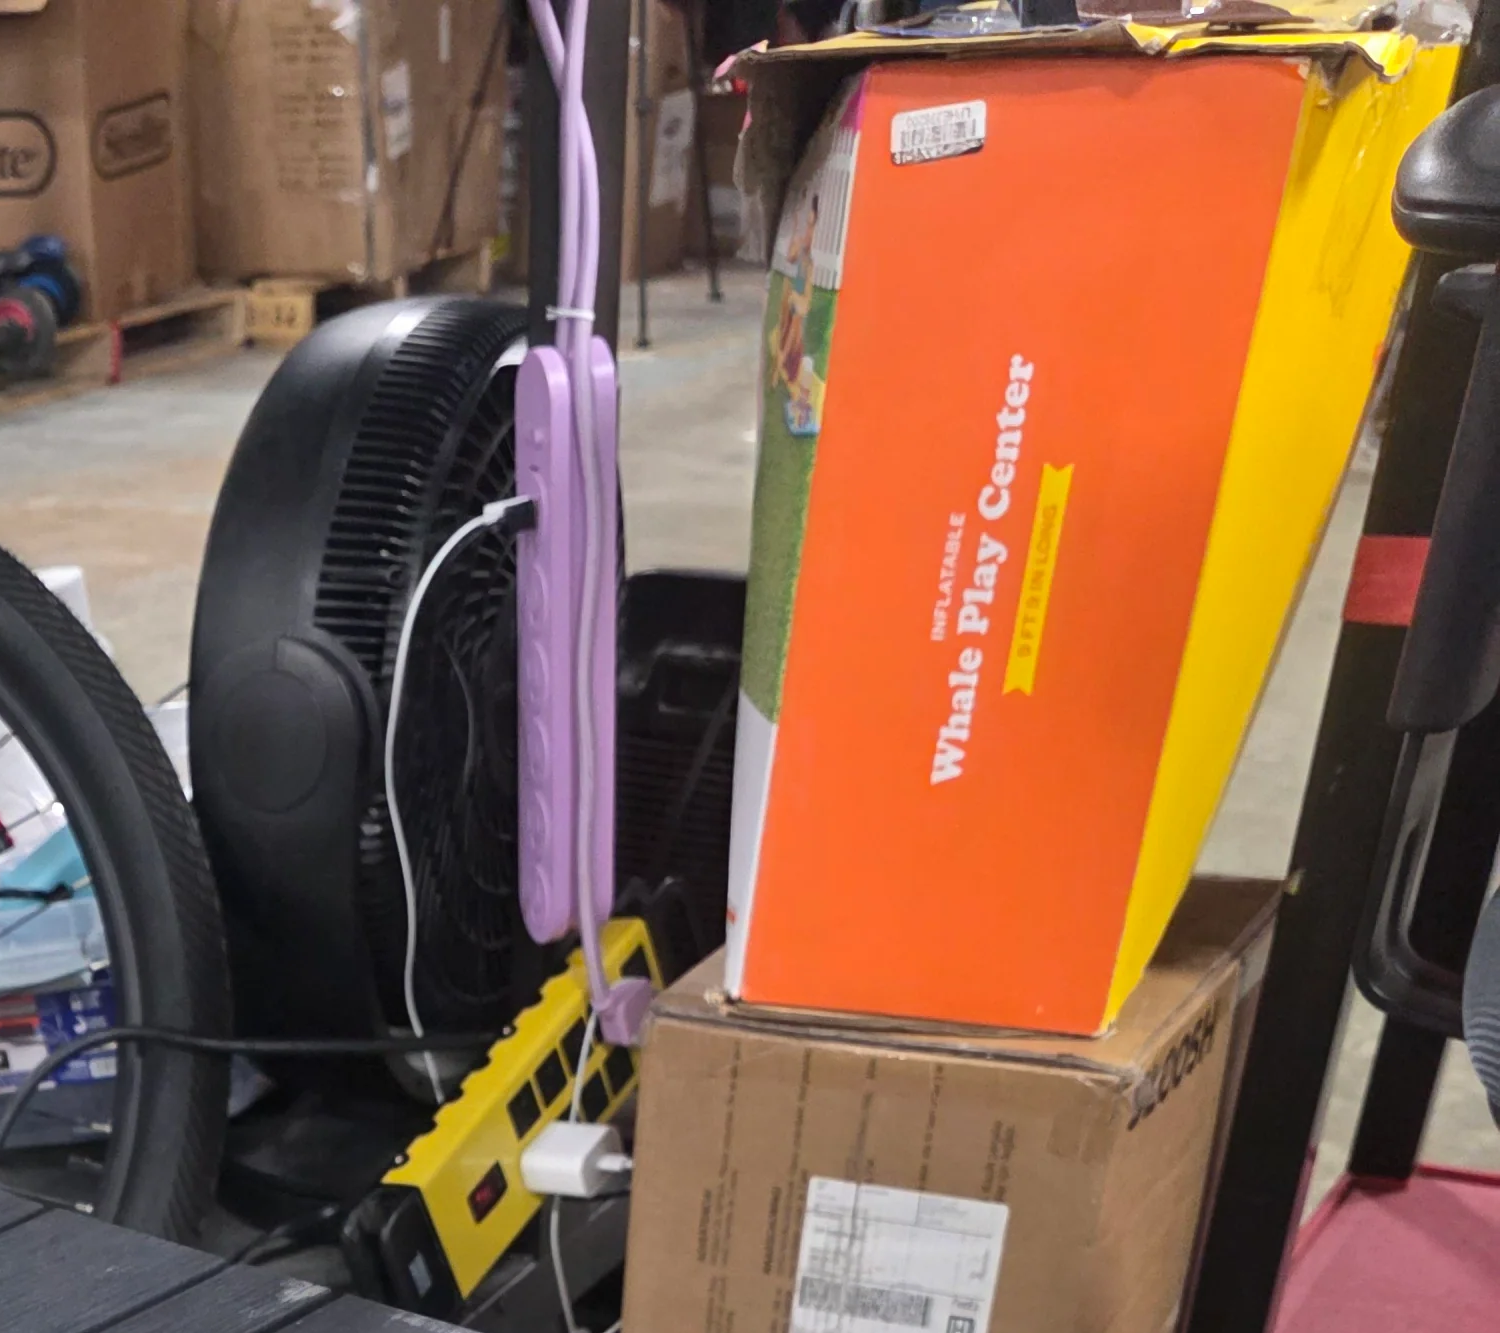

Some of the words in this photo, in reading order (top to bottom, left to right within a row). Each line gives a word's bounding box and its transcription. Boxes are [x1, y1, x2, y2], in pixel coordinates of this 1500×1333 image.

[978, 354, 1034, 520] Center
[930, 513, 966, 641] INFLATABLE
[956, 532, 1008, 635] Play
[1035, 504, 1058, 567] LONG
[930, 647, 983, 785] Whale
